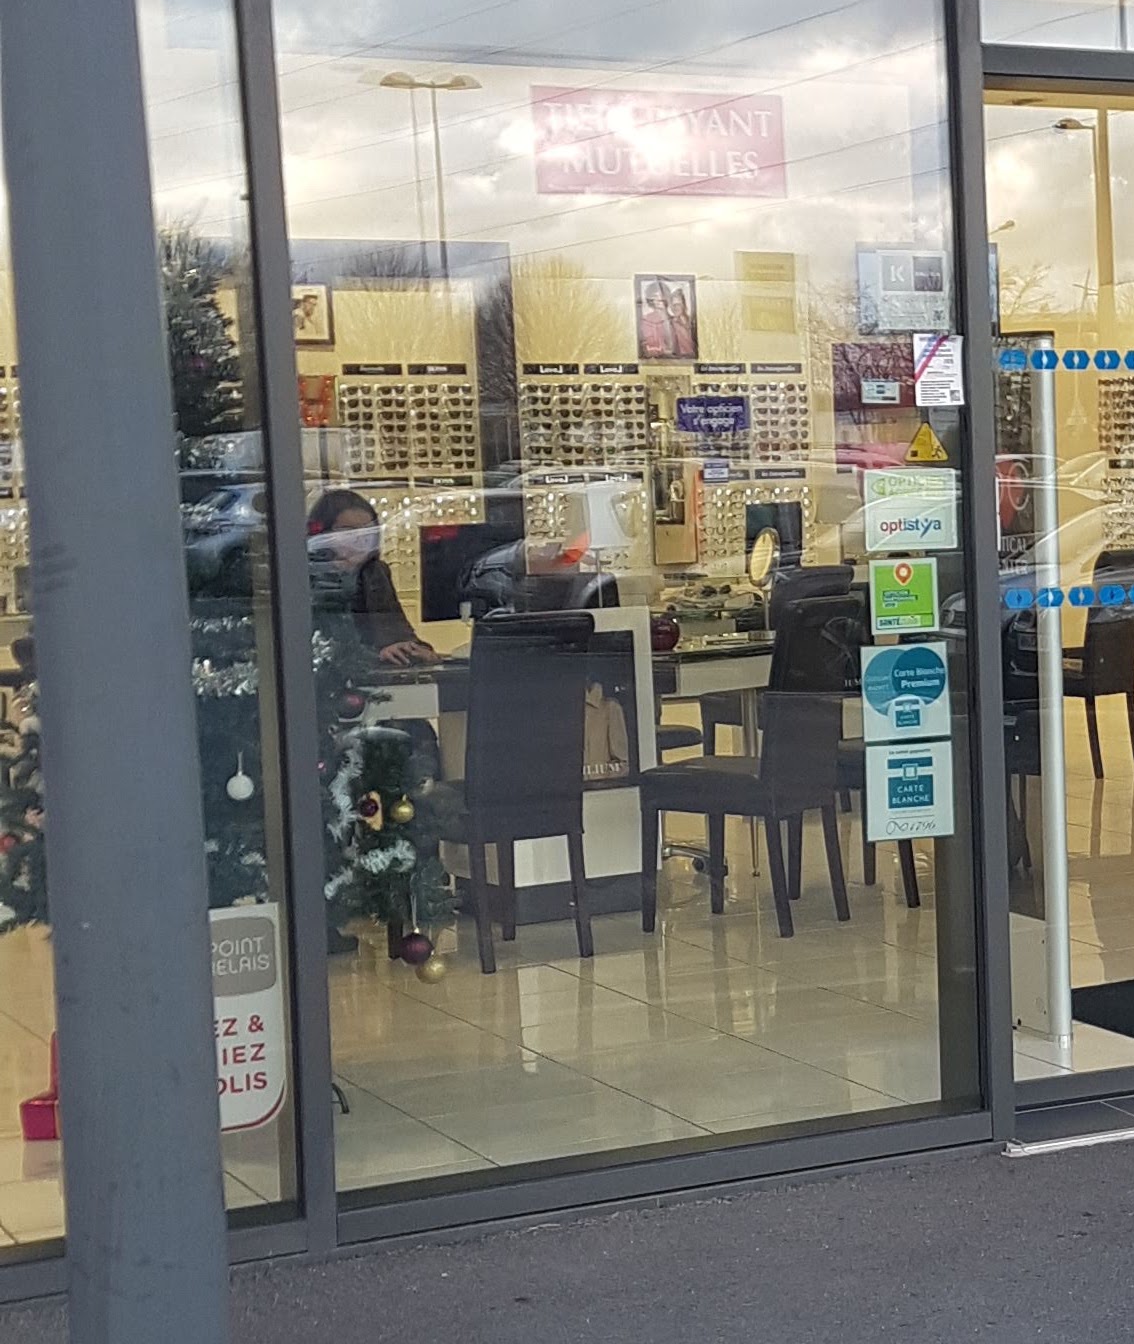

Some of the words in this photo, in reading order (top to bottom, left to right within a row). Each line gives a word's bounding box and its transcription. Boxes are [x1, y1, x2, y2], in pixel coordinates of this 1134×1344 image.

[894, 669, 915, 678] Carte
[901, 678, 940, 689] Premium
[897, 784, 924, 794] CARTE
[892, 794, 930, 805] BLANCHE
[212, 954, 270, 977] ELAIS
[247, 1014, 265, 1033] &
[217, 1071, 268, 1096] OLIS
